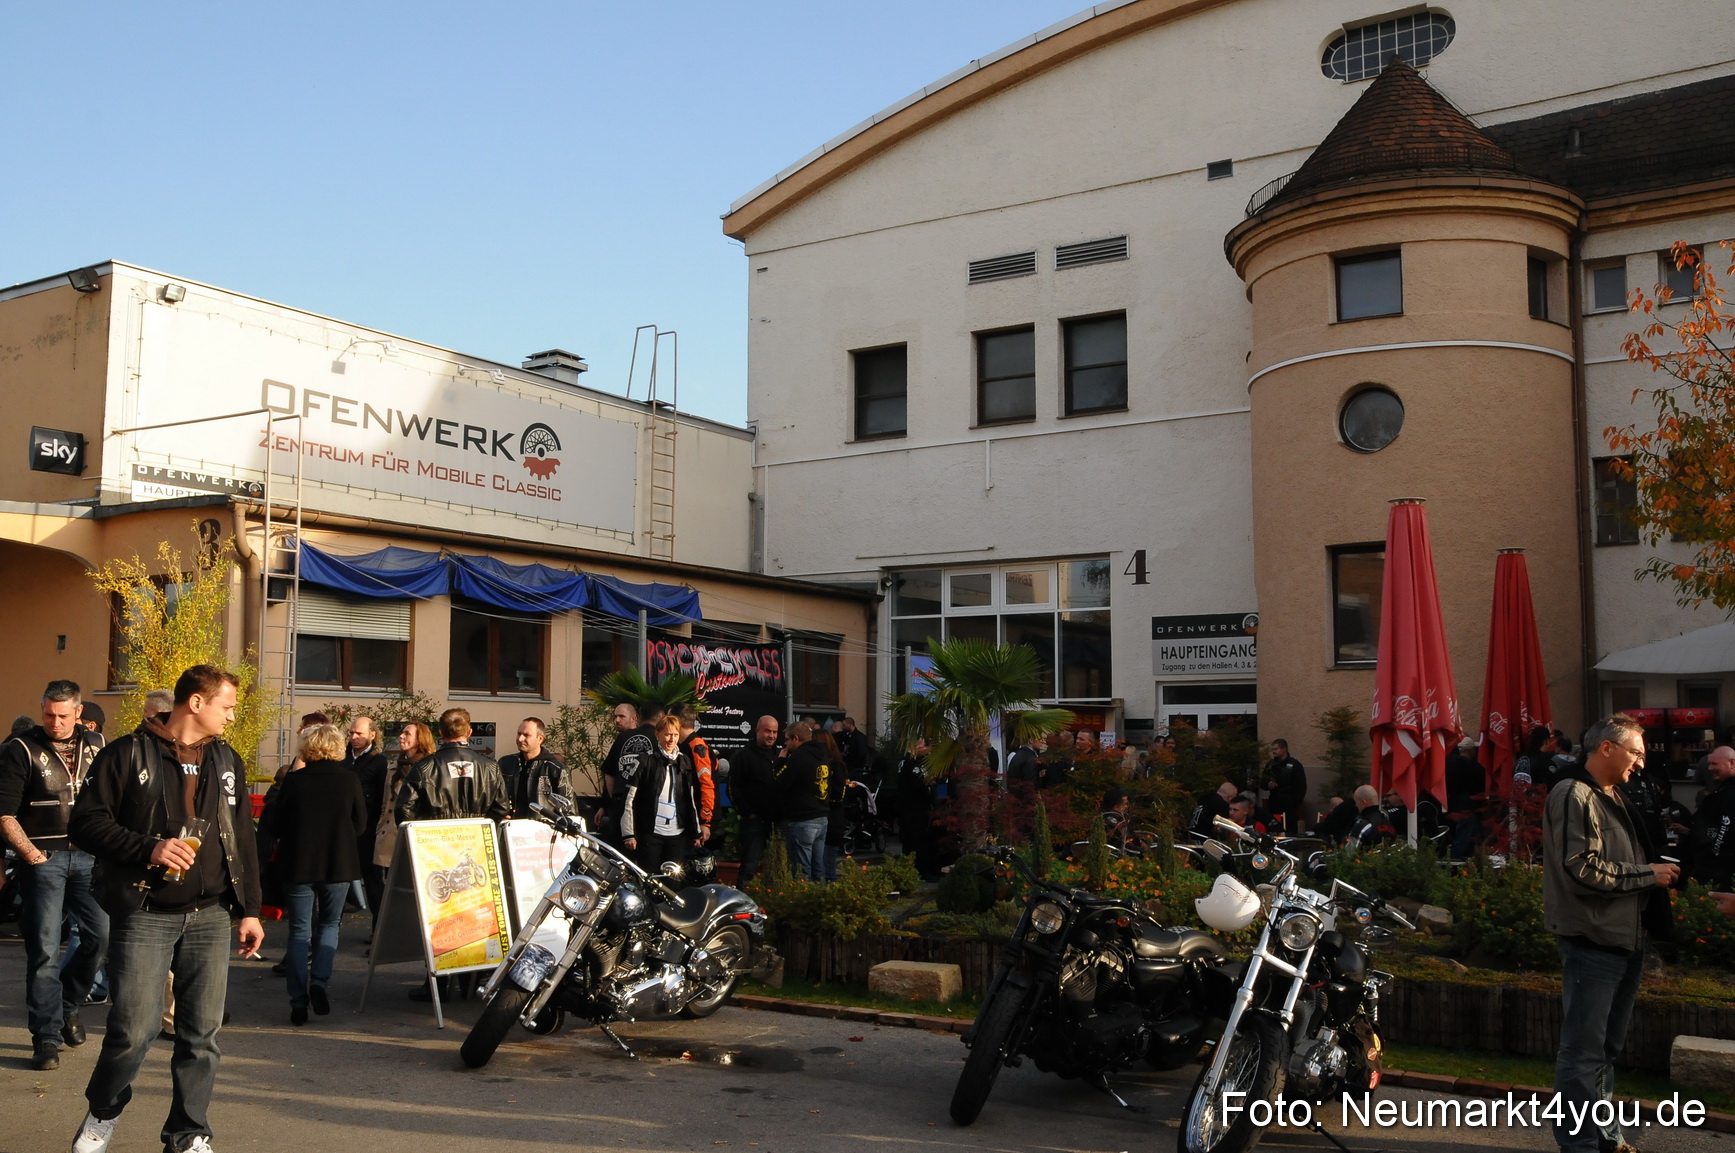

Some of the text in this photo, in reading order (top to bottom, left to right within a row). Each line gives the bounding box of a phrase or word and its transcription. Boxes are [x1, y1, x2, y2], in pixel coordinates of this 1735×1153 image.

[261, 378, 516, 462] OFENWERK
[40, 438, 78, 464] sky
[137, 464, 247, 490] OFENWERK
[371, 450, 409, 474] FÜR
[417, 459, 486, 488] MOBILE
[492, 474, 562, 502] CLASSIC
[1123, 549, 1151, 586] 4
[1156, 623, 1238, 634] OFENWERK
[1160, 643, 1257, 660] HAUPTEINGANG
[1162, 663, 1186, 672] Zugang
[1197, 662, 1210, 670] den
[1211, 662, 1232, 670] Hallen
[1241, 661, 1246, 669] 3
